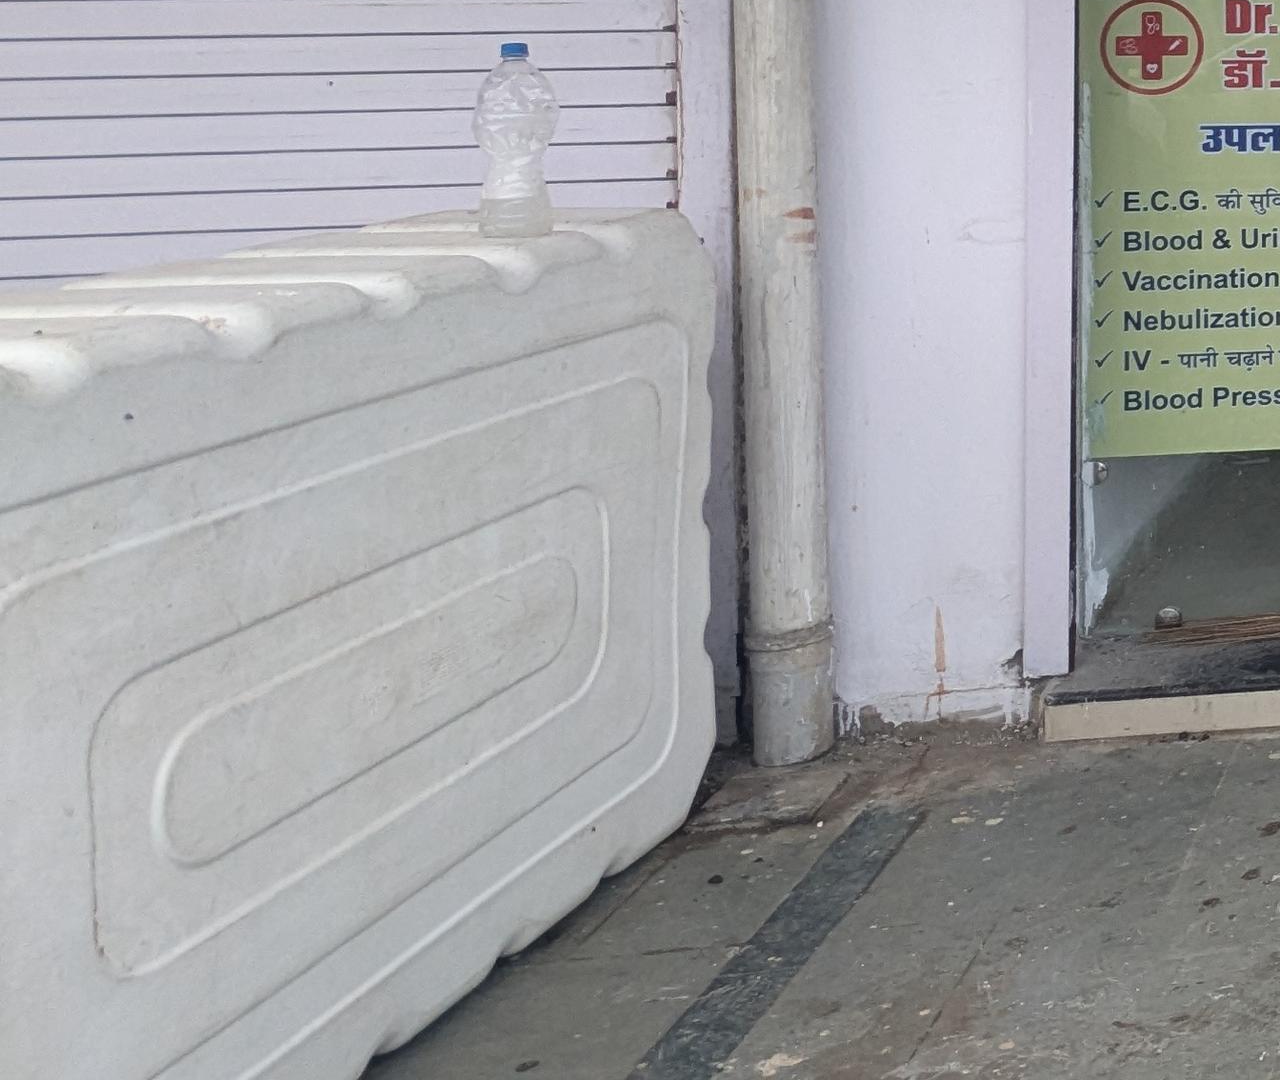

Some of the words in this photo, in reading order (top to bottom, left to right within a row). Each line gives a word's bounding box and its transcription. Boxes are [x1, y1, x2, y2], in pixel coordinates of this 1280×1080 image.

[1123, 190, 1207, 212] E.C.G.
[1215, 188, 1243, 210] की
[1123, 230, 1202, 252] Blood
[1212, 229, 1231, 249] &
[1122, 268, 1279, 291] Vaccination
[1124, 350, 1151, 371] IV
[1177, 347, 1219, 368] पानी
[1124, 388, 1203, 411] Blood
